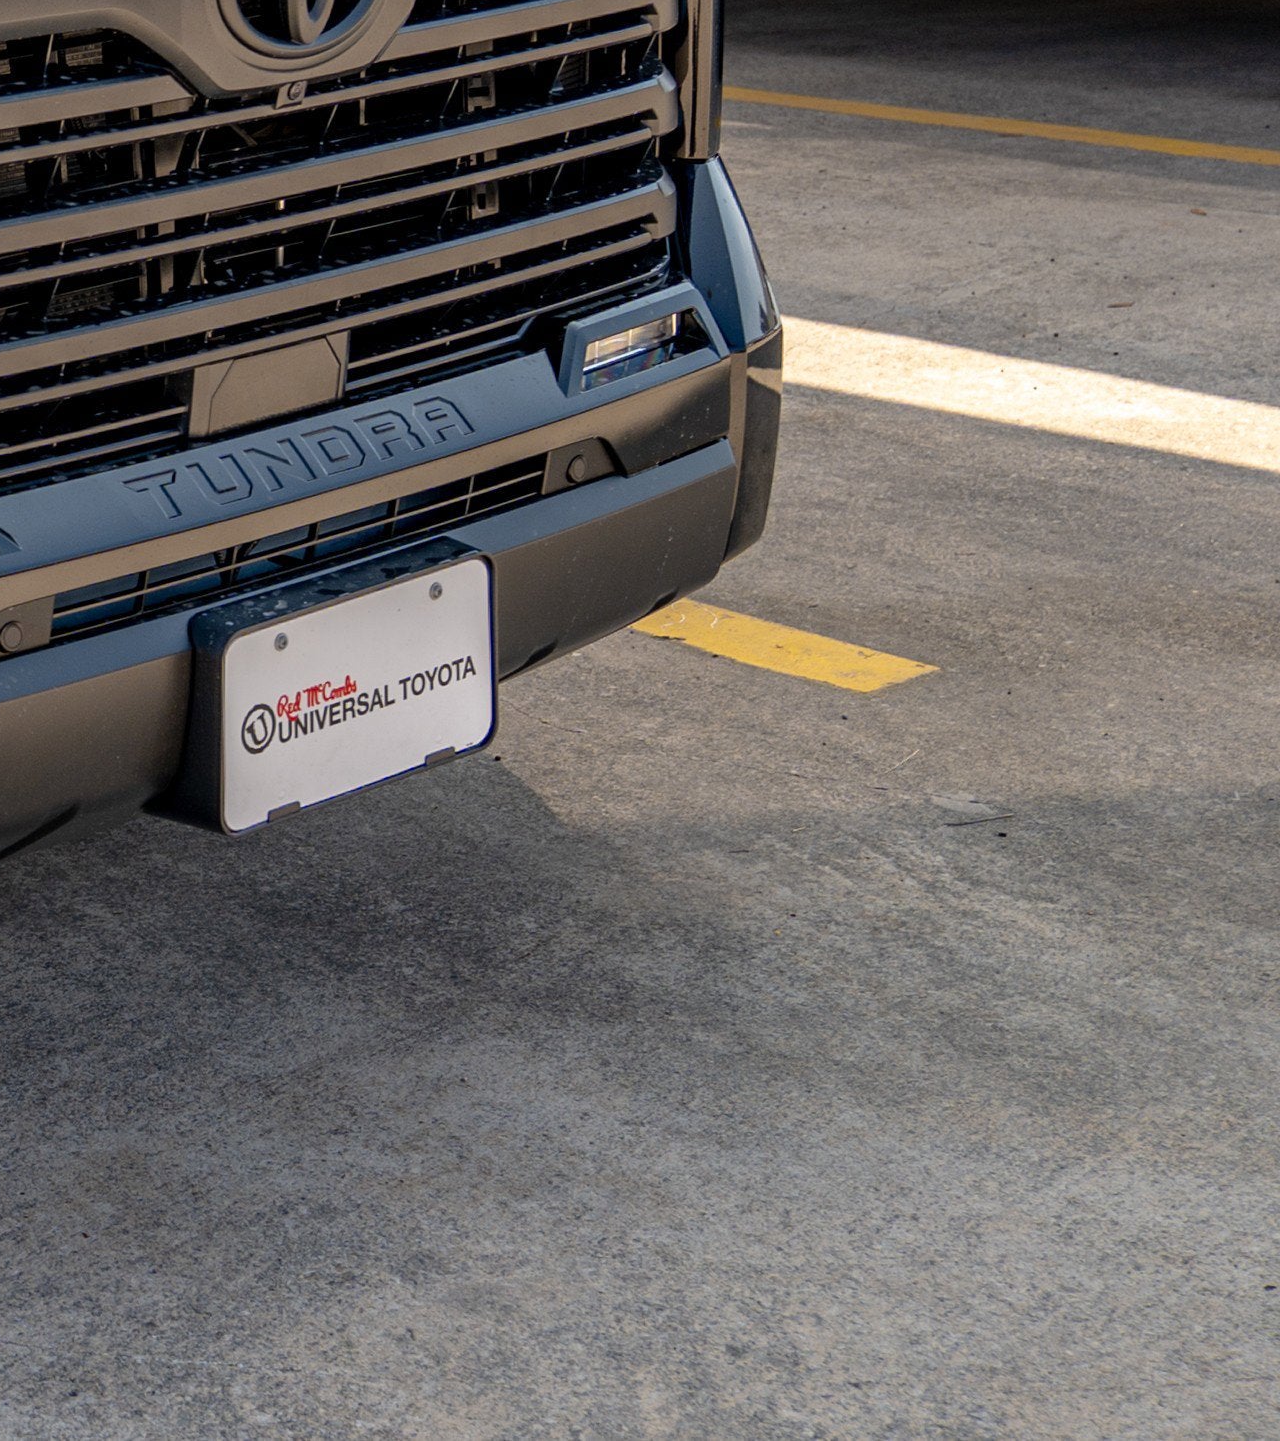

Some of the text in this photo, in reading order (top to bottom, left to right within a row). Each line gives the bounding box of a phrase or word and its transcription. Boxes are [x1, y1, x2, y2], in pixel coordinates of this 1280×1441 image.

[121, 396, 477, 520] TUNDRA
[277, 694, 301, 722] Red
[278, 655, 476, 743] UNIVERSAL TOYOTA
